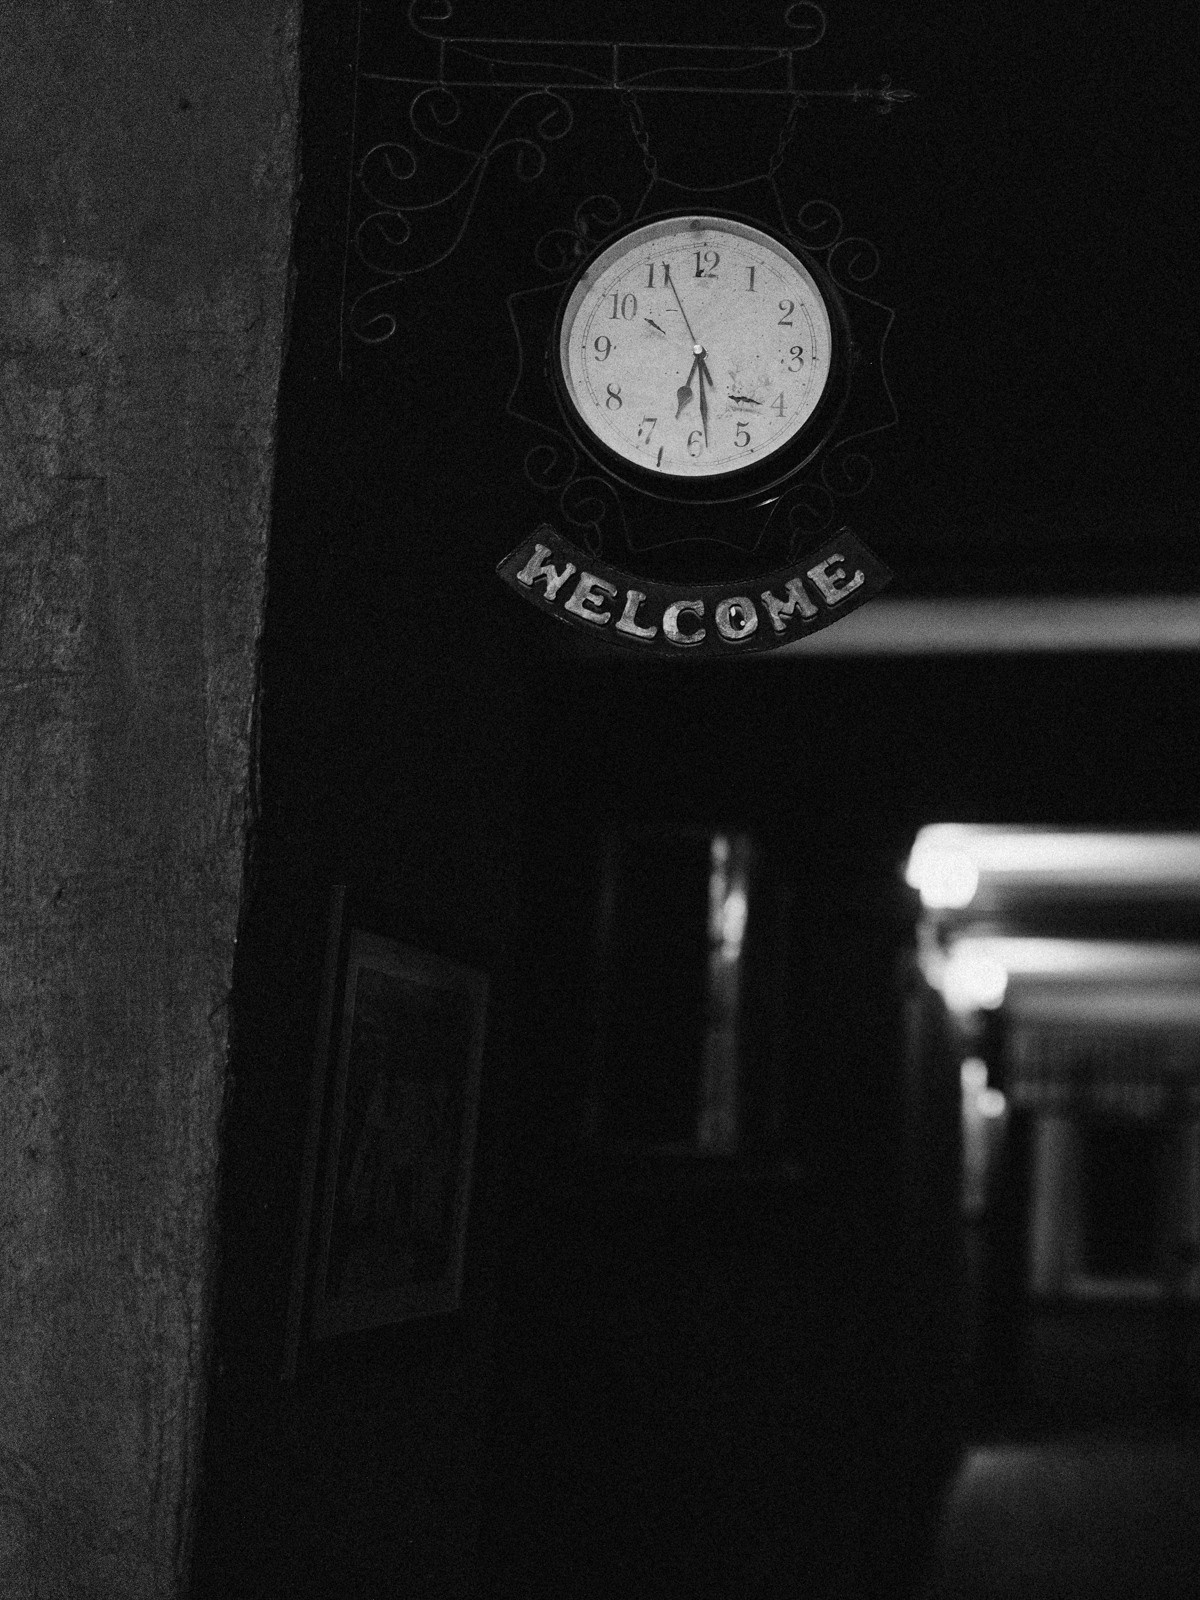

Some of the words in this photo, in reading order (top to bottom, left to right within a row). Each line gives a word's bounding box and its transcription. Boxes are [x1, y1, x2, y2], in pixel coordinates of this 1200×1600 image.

[646, 263, 671, 289] 11
[693, 251, 720, 278] 12
[746, 266, 755, 292] 1
[609, 293, 637, 320] 10
[777, 299, 795, 326] 2
[594, 335, 611, 361] 9
[788, 346, 804, 372] 3
[606, 383, 622, 409] 8
[770, 392, 788, 417] 4
[642, 418, 658, 444] 7
[687, 430, 703, 457] 6
[734, 421, 751, 448] 5
[517, 543, 865, 644] WELCOME
